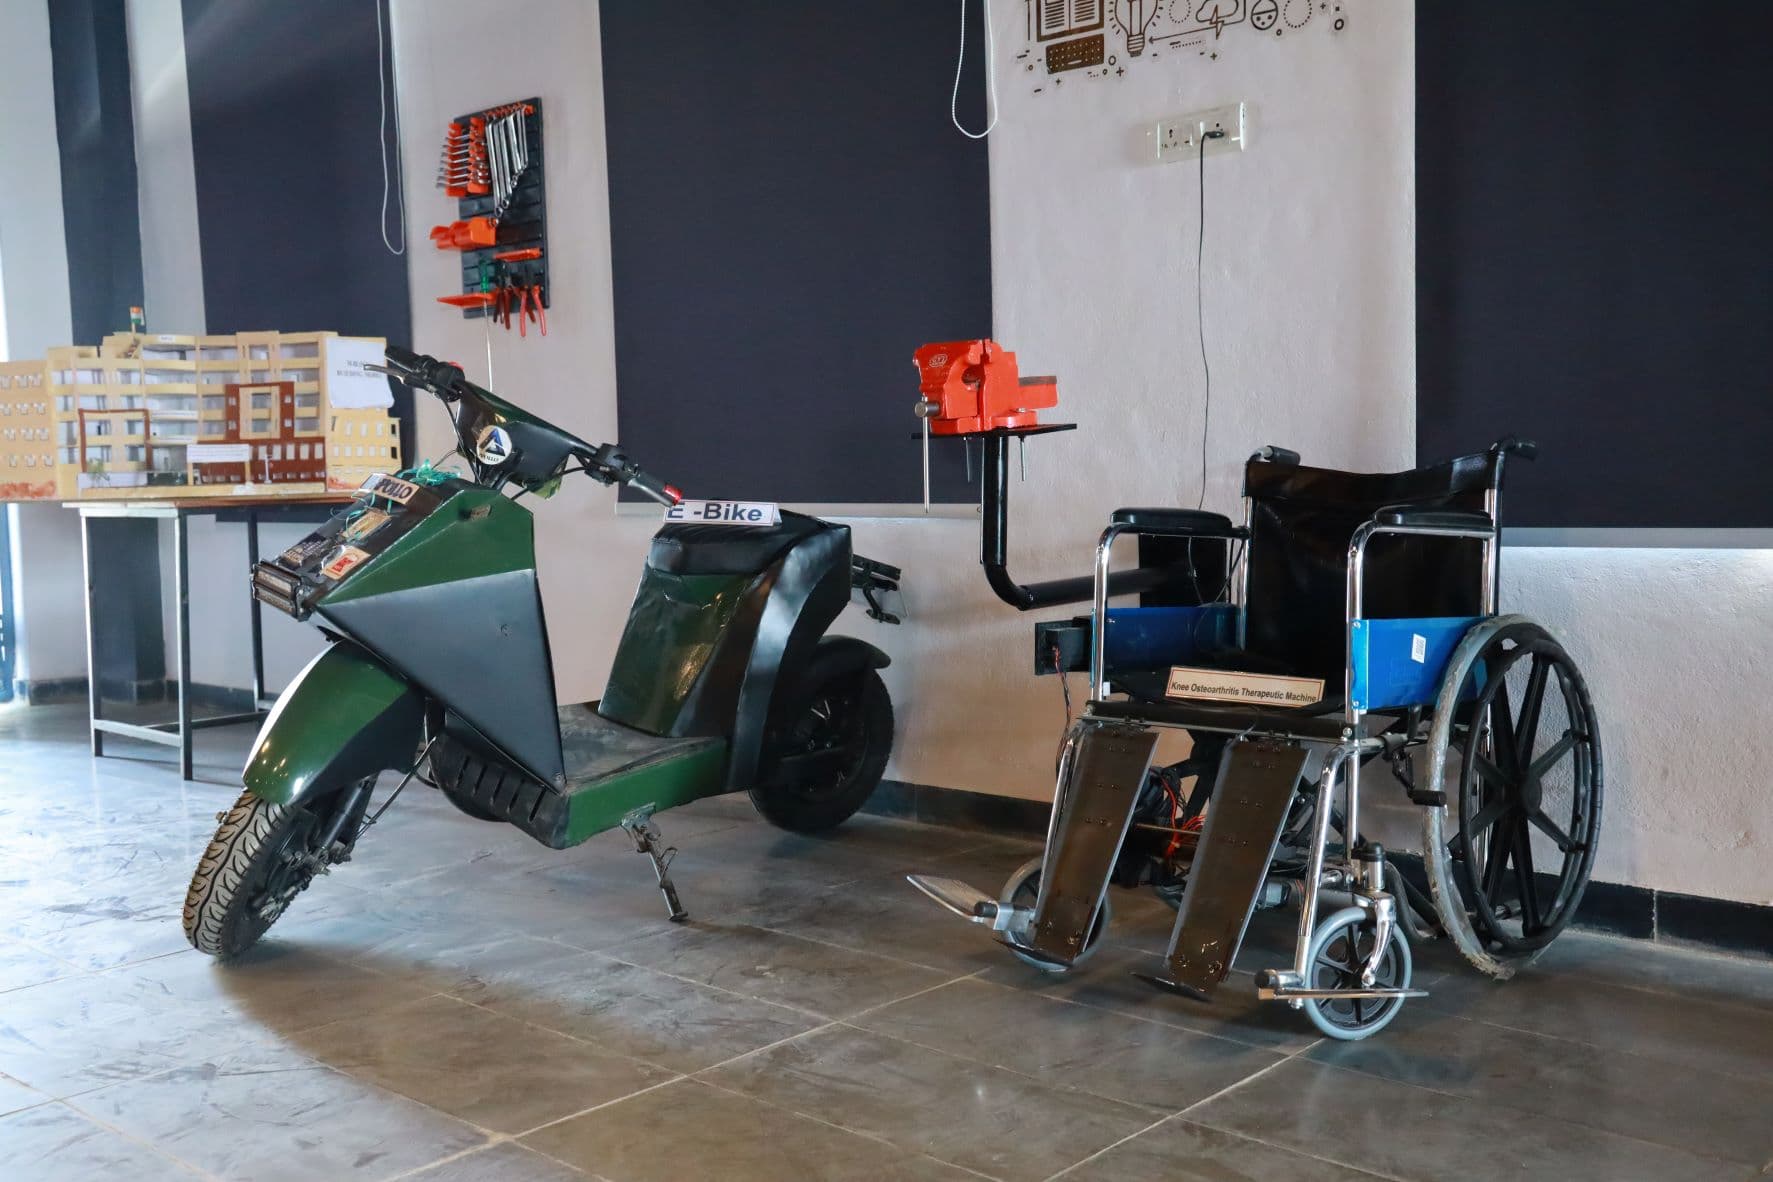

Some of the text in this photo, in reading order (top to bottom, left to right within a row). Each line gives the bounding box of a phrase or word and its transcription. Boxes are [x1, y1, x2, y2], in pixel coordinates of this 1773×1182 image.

[371, 477, 413, 499] POLLO
[1171, 681, 1317, 703] Knee Osteoarthritis Therapeutic Machine
